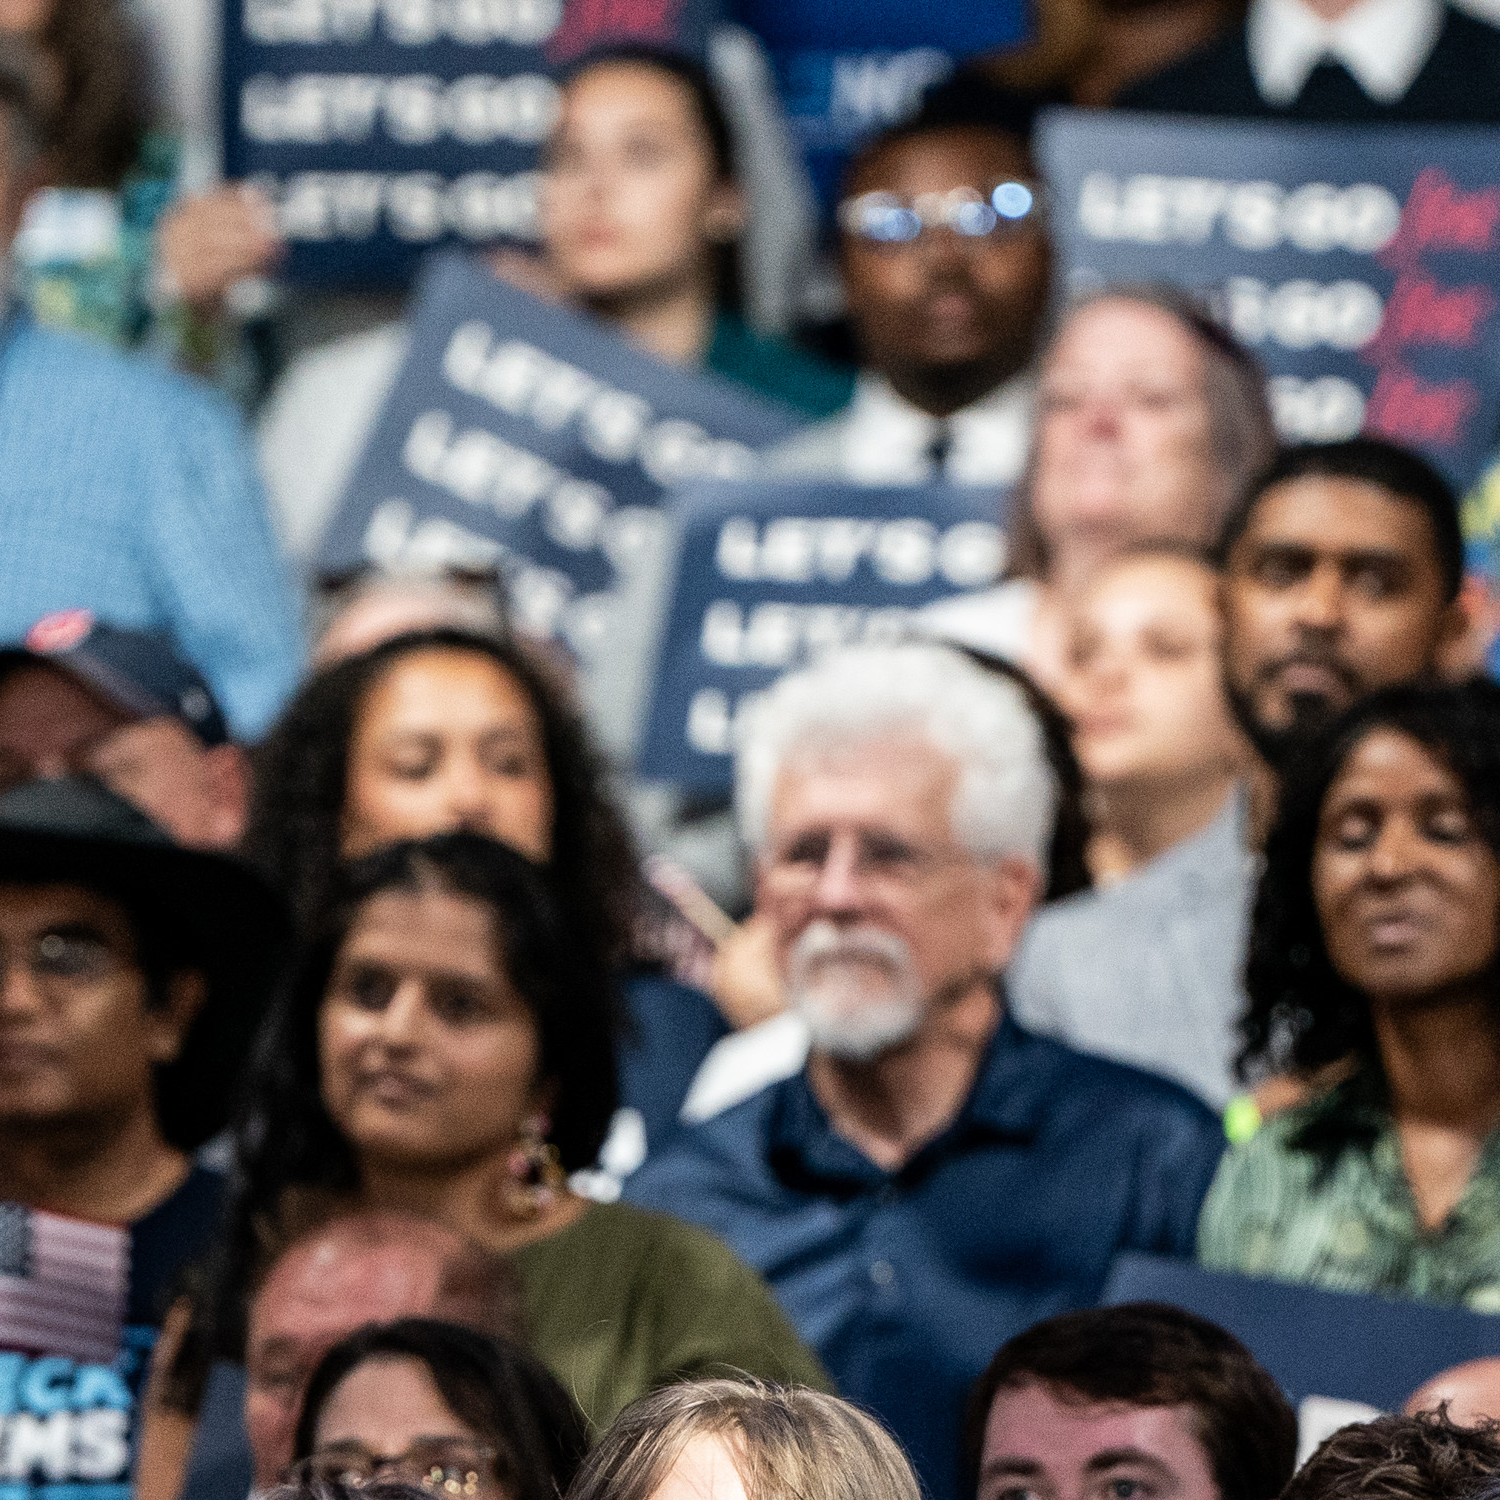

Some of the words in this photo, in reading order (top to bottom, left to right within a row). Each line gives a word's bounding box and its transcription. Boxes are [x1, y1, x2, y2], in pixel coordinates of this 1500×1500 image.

[1079, 171, 1285, 251] LET'S
[1287, 181, 1400, 254] GO
[717, 516, 934, 584] LET'S
